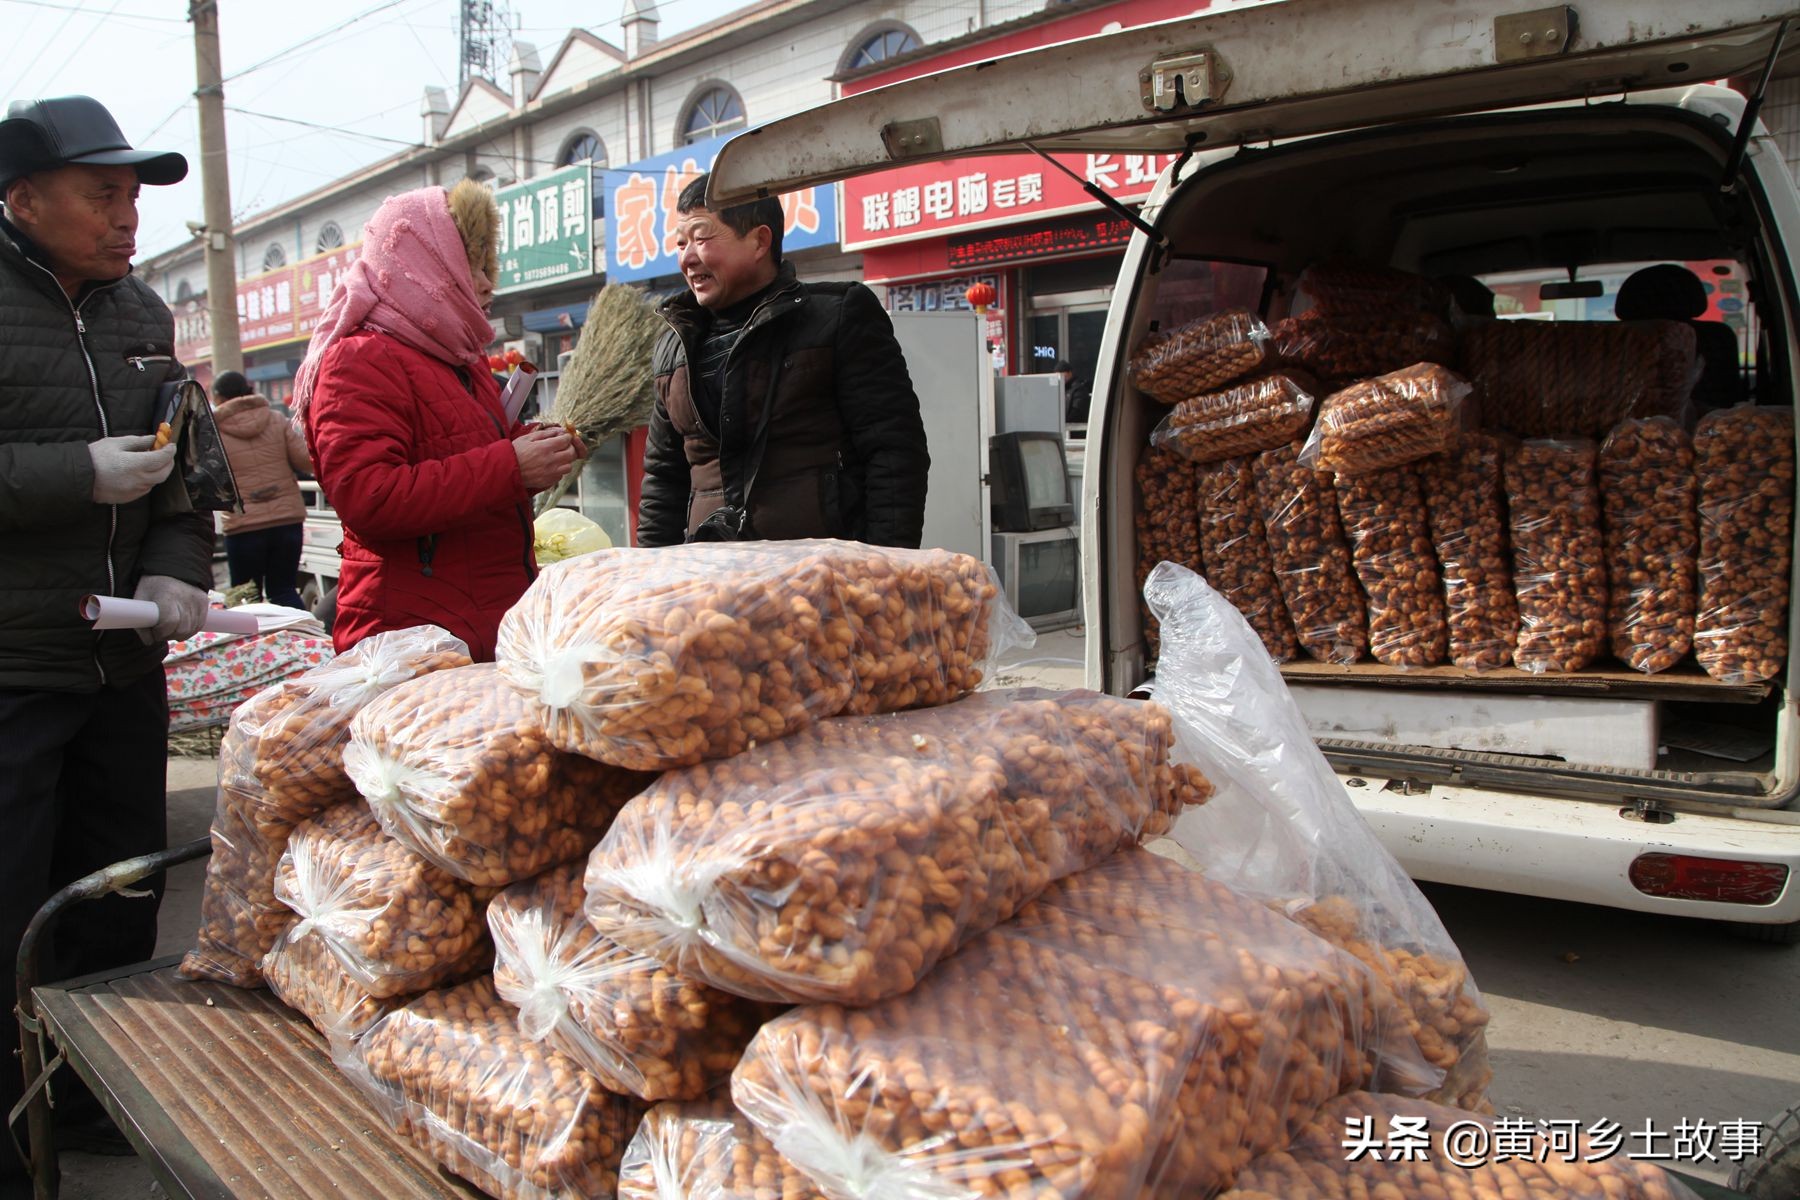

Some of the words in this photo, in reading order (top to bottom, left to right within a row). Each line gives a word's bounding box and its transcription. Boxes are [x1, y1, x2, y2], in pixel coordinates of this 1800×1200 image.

[1086, 153, 1177, 189] 长虹
[861, 171, 1043, 232] 联想电脑专卖
